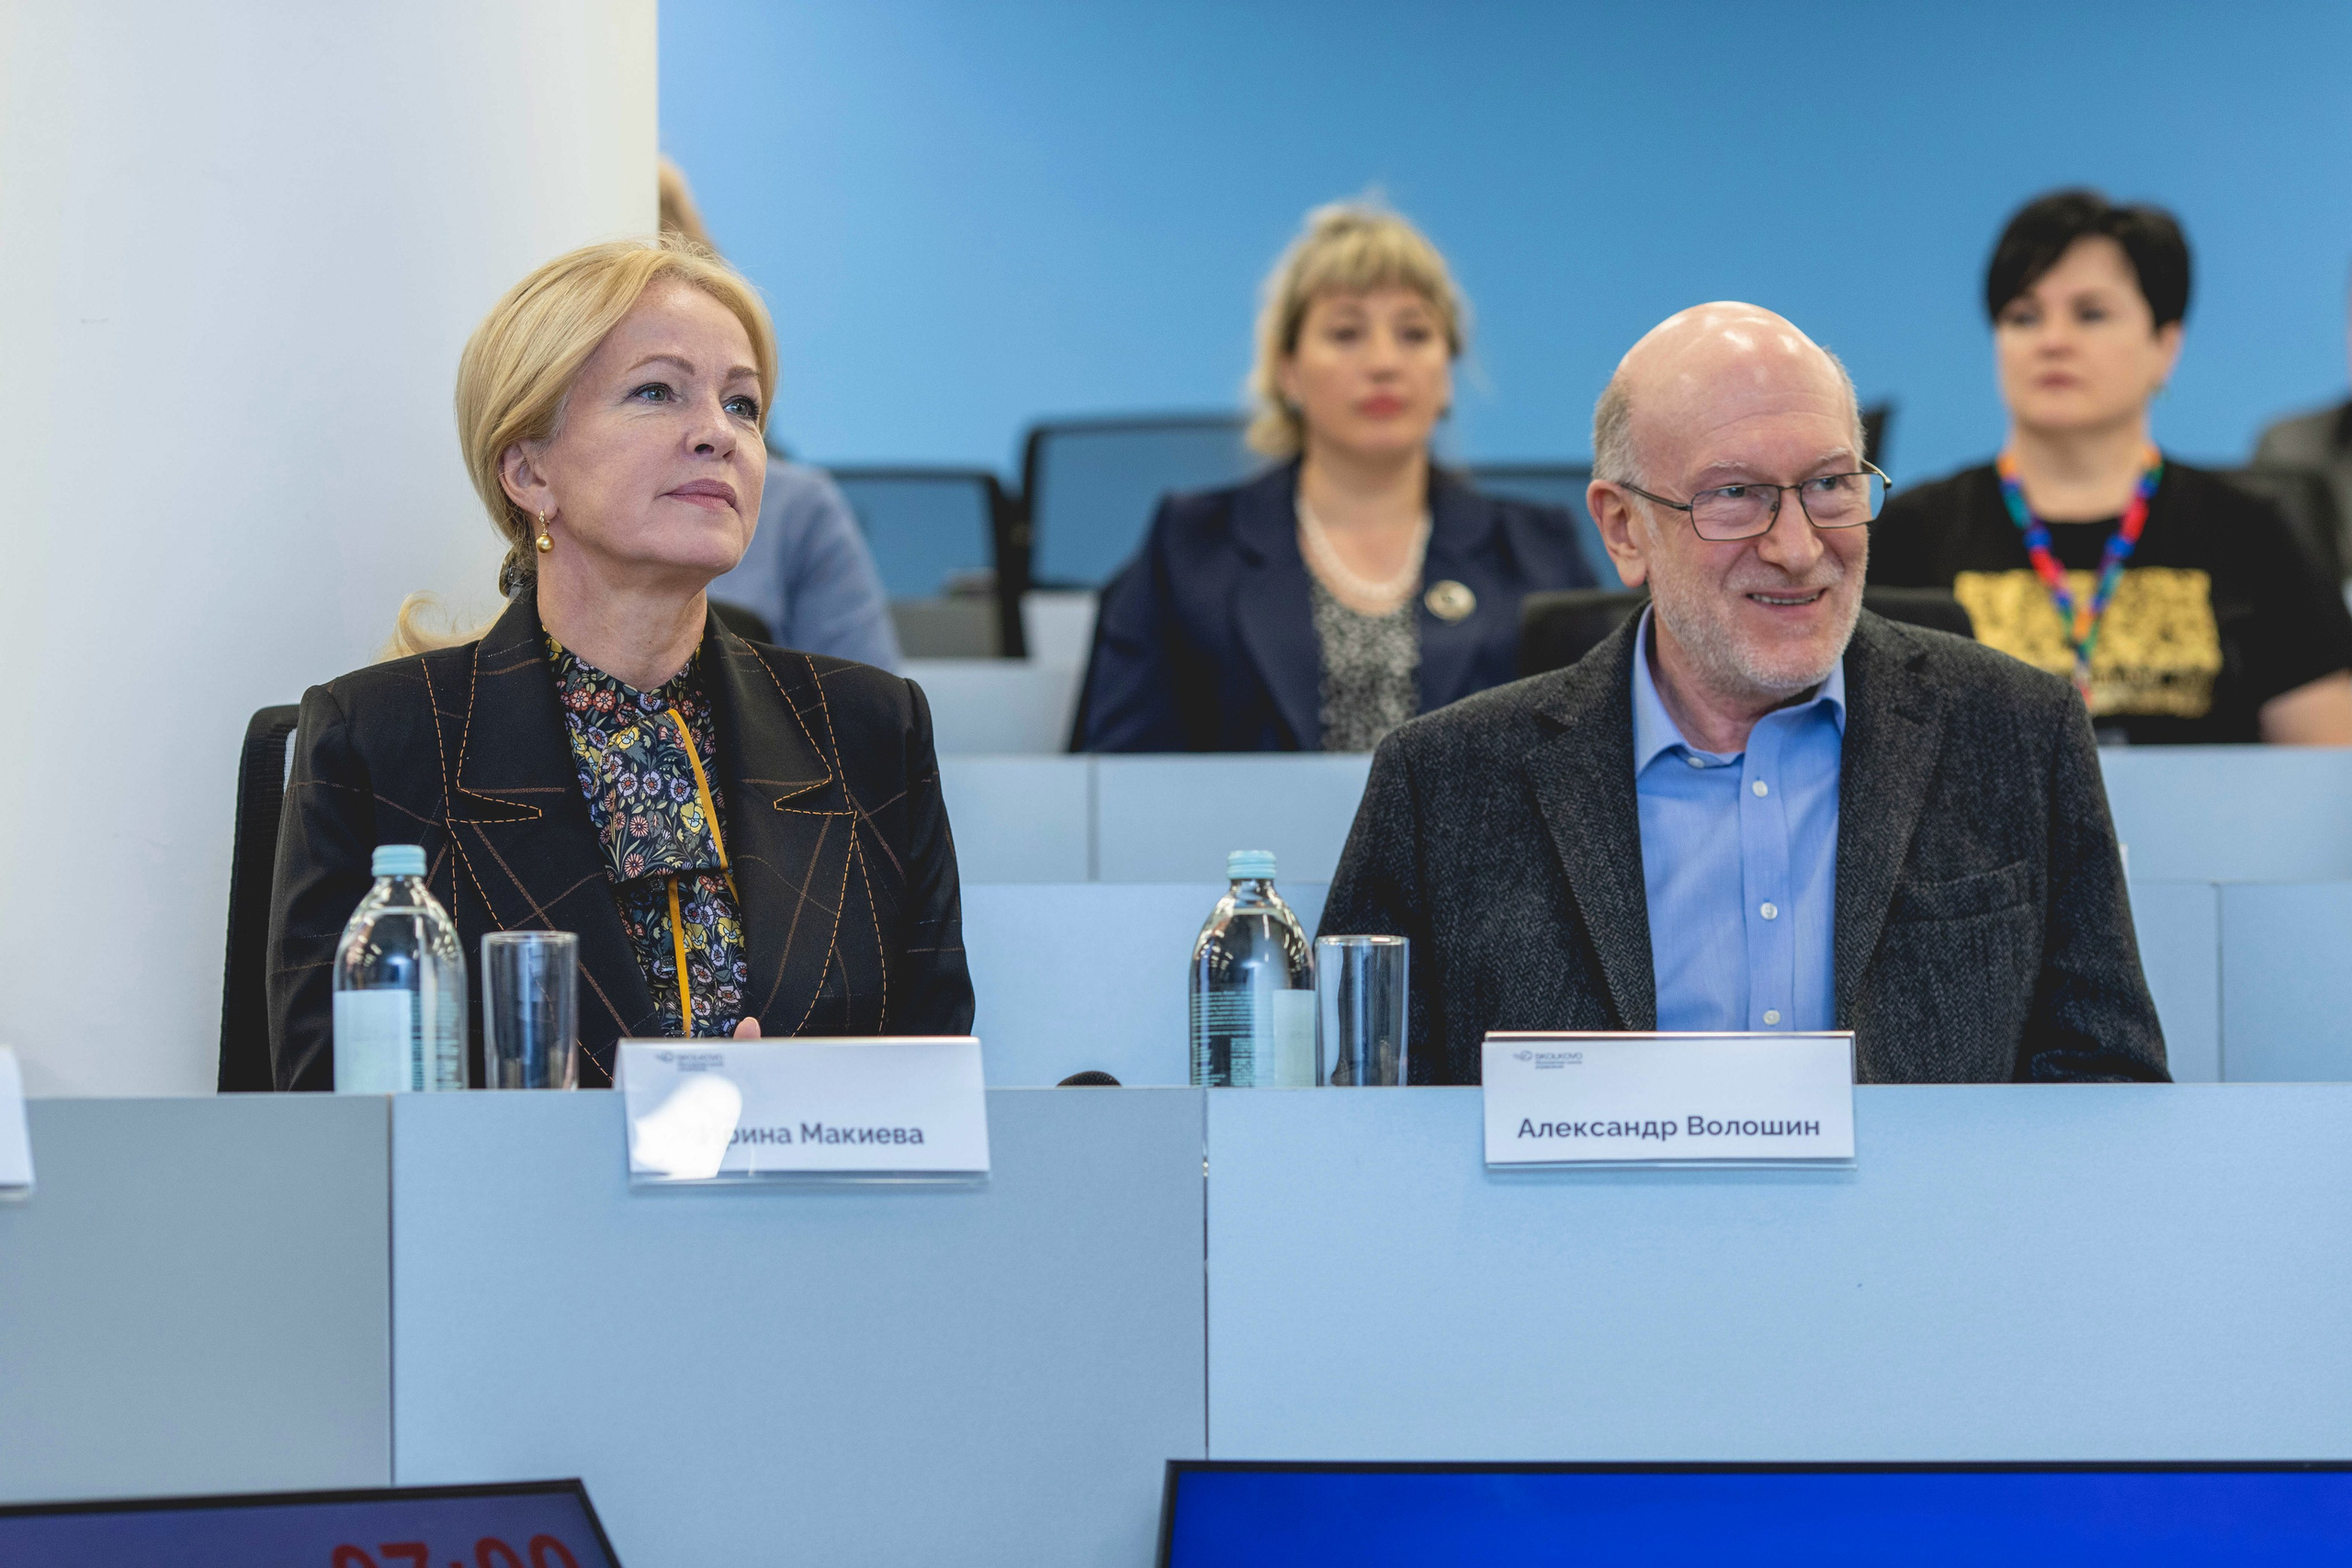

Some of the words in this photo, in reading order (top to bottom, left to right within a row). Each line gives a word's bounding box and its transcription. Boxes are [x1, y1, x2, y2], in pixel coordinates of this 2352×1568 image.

[722, 1126, 793, 1151] рина
[800, 1122, 924, 1145] Макиева
[1518, 1118, 1678, 1142] Александр
[1687, 1115, 1820, 1136] Волошин
